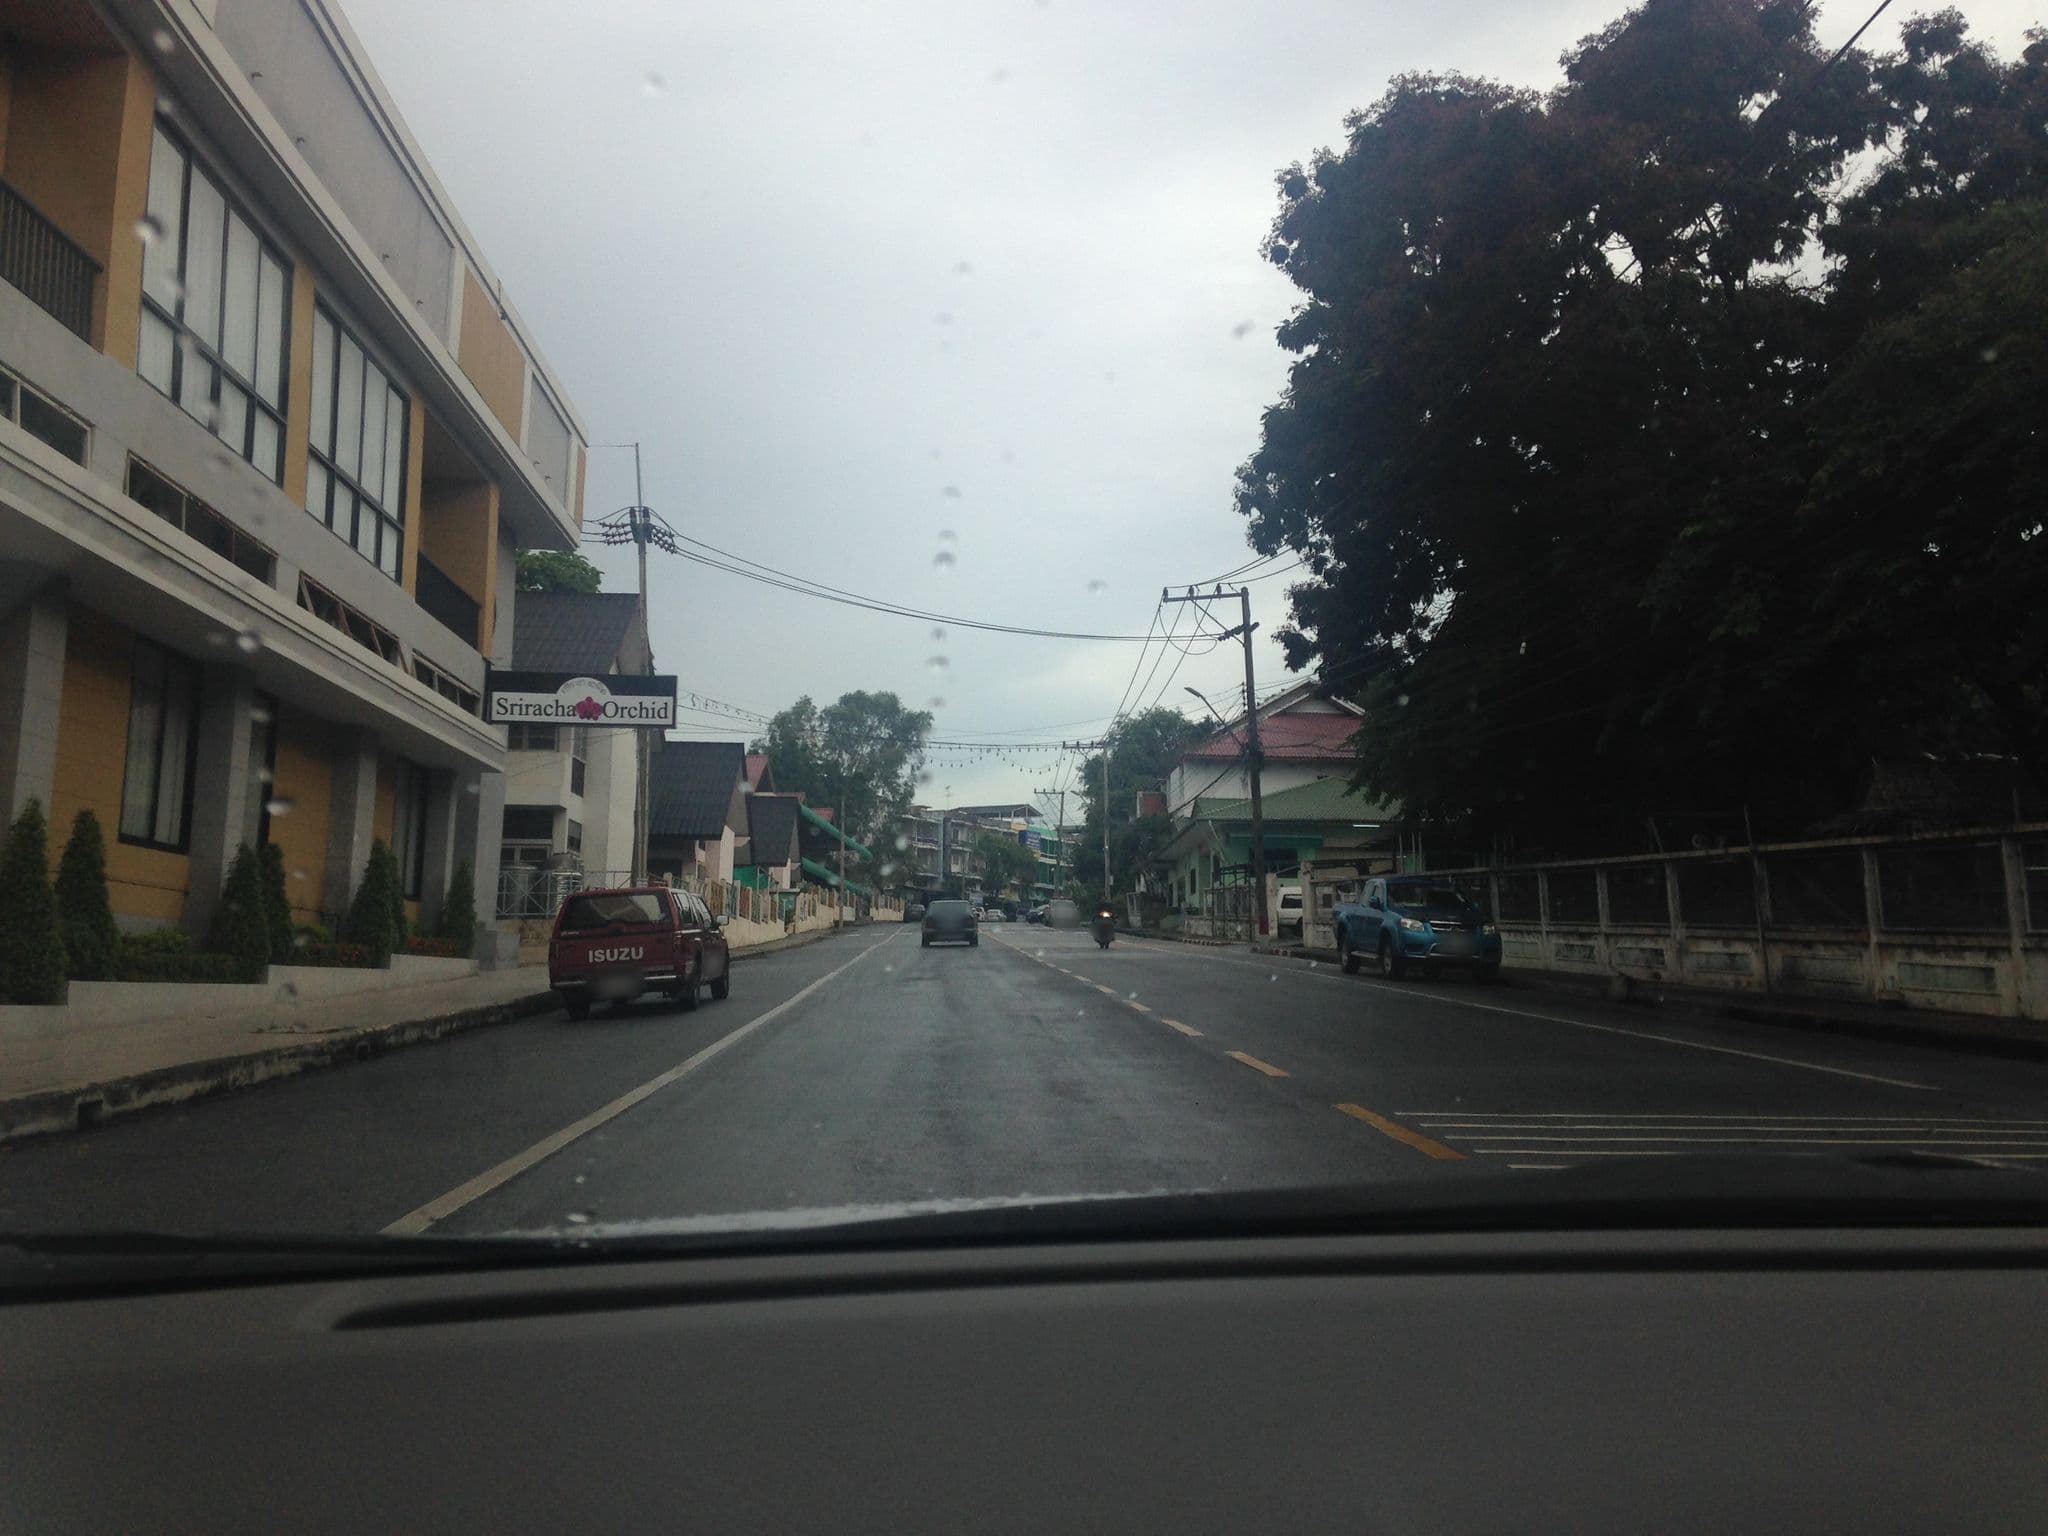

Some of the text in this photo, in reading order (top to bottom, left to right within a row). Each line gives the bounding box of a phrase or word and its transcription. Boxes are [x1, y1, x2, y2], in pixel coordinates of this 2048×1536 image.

[496, 697, 668, 719] Sriracha Orchid
[588, 946, 644, 963] ISUZU
